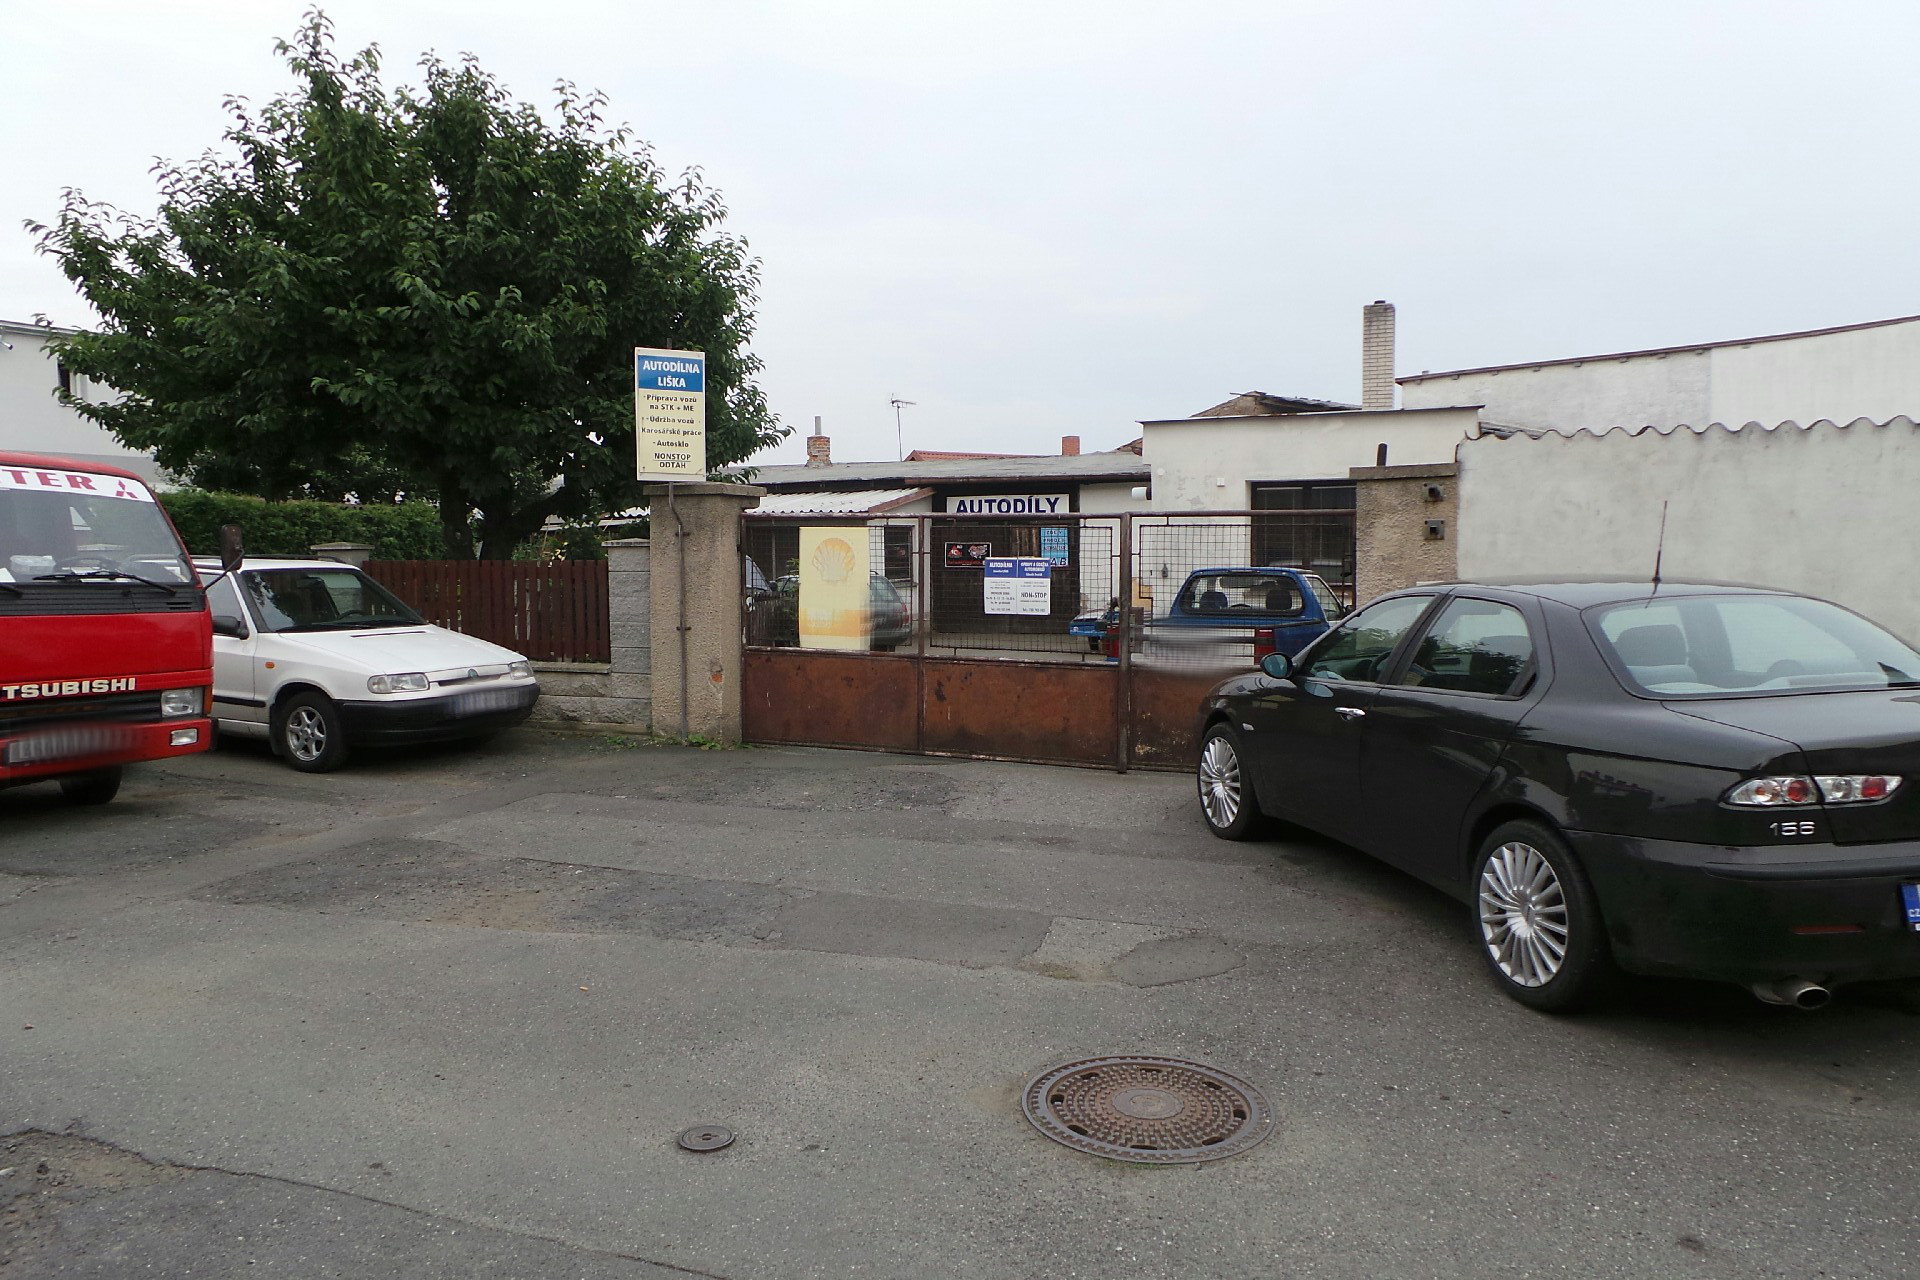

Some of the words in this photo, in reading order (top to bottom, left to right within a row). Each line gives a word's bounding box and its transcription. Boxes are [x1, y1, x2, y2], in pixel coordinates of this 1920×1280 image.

[643, 360, 700, 374] AUTODÍLNA
[657, 375, 686, 388] LIŠKA
[660, 403, 675, 411] STK
[656, 440, 689, 448] Autosklo
[654, 452, 692, 461] NONSTOP
[659, 461, 686, 469] ODTAH
[0, 469, 97, 491] TER
[956, 495, 1060, 514] AUTODÍLY
[1020, 591, 1048, 599] NON-STOP
[1769, 821, 1815, 836] 156
